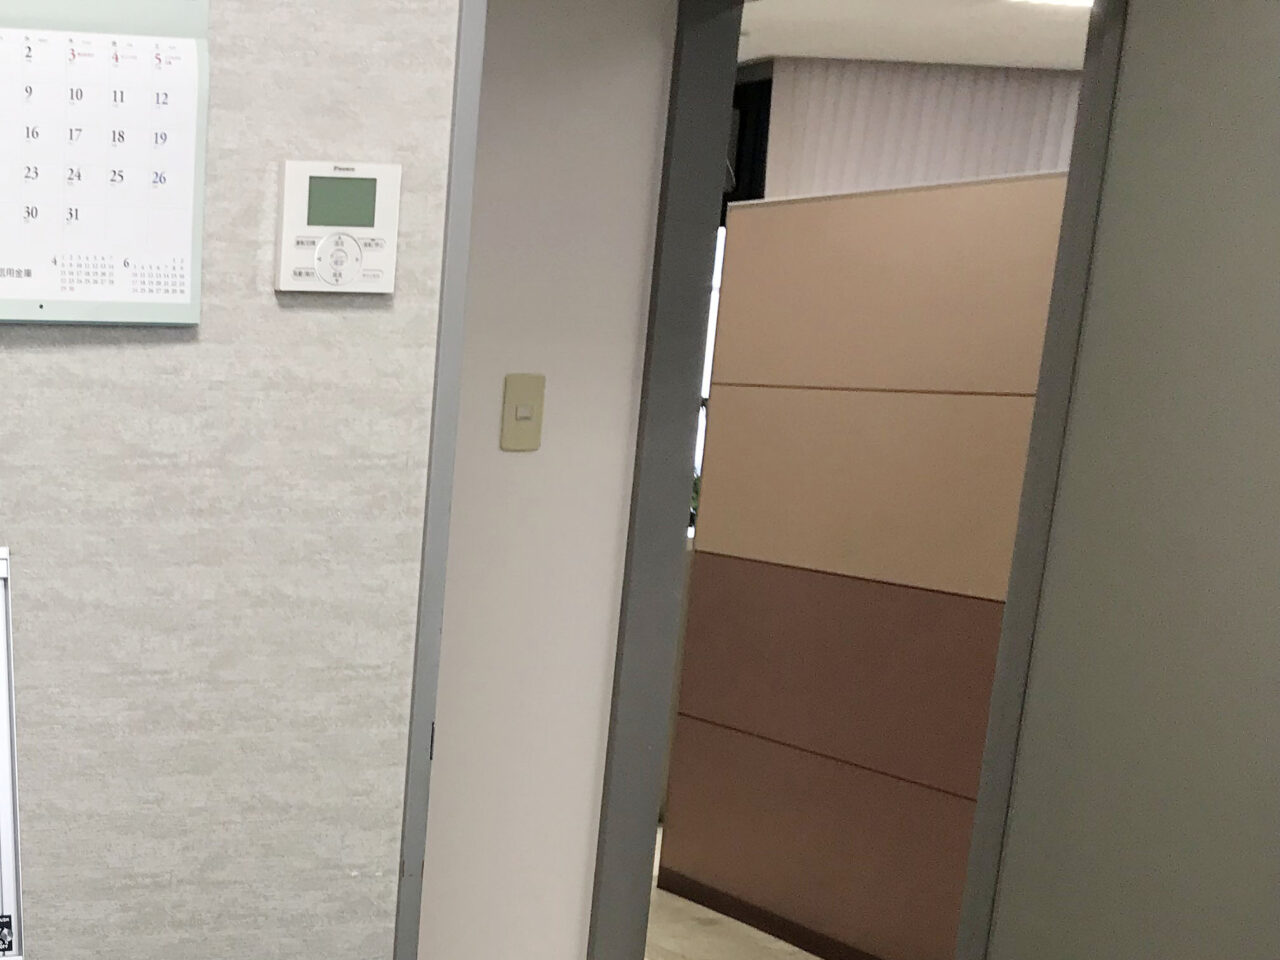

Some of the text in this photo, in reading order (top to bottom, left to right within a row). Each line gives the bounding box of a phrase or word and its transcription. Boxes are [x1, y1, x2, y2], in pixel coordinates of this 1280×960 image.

[25, 46, 33, 58] 2
[69, 48, 76, 61] 3
[112, 50, 119, 63] 4
[155, 53, 162, 65] 5
[25, 86, 33, 98] 9
[70, 88, 83, 101] 10
[113, 90, 124, 103] 11
[155, 92, 169, 105] 12
[25, 126, 39, 139] 16
[69, 128, 82, 141] 17
[111, 130, 125, 143] 18
[154, 132, 167, 144] 19
[24, 166, 39, 179] 23
[67, 168, 82, 181] 24
[110, 170, 124, 183] 25
[152, 171, 167, 184] 26
[24, 206, 38, 220] 30
[66, 208, 79, 221] 31
[123, 257, 130, 268] 6
